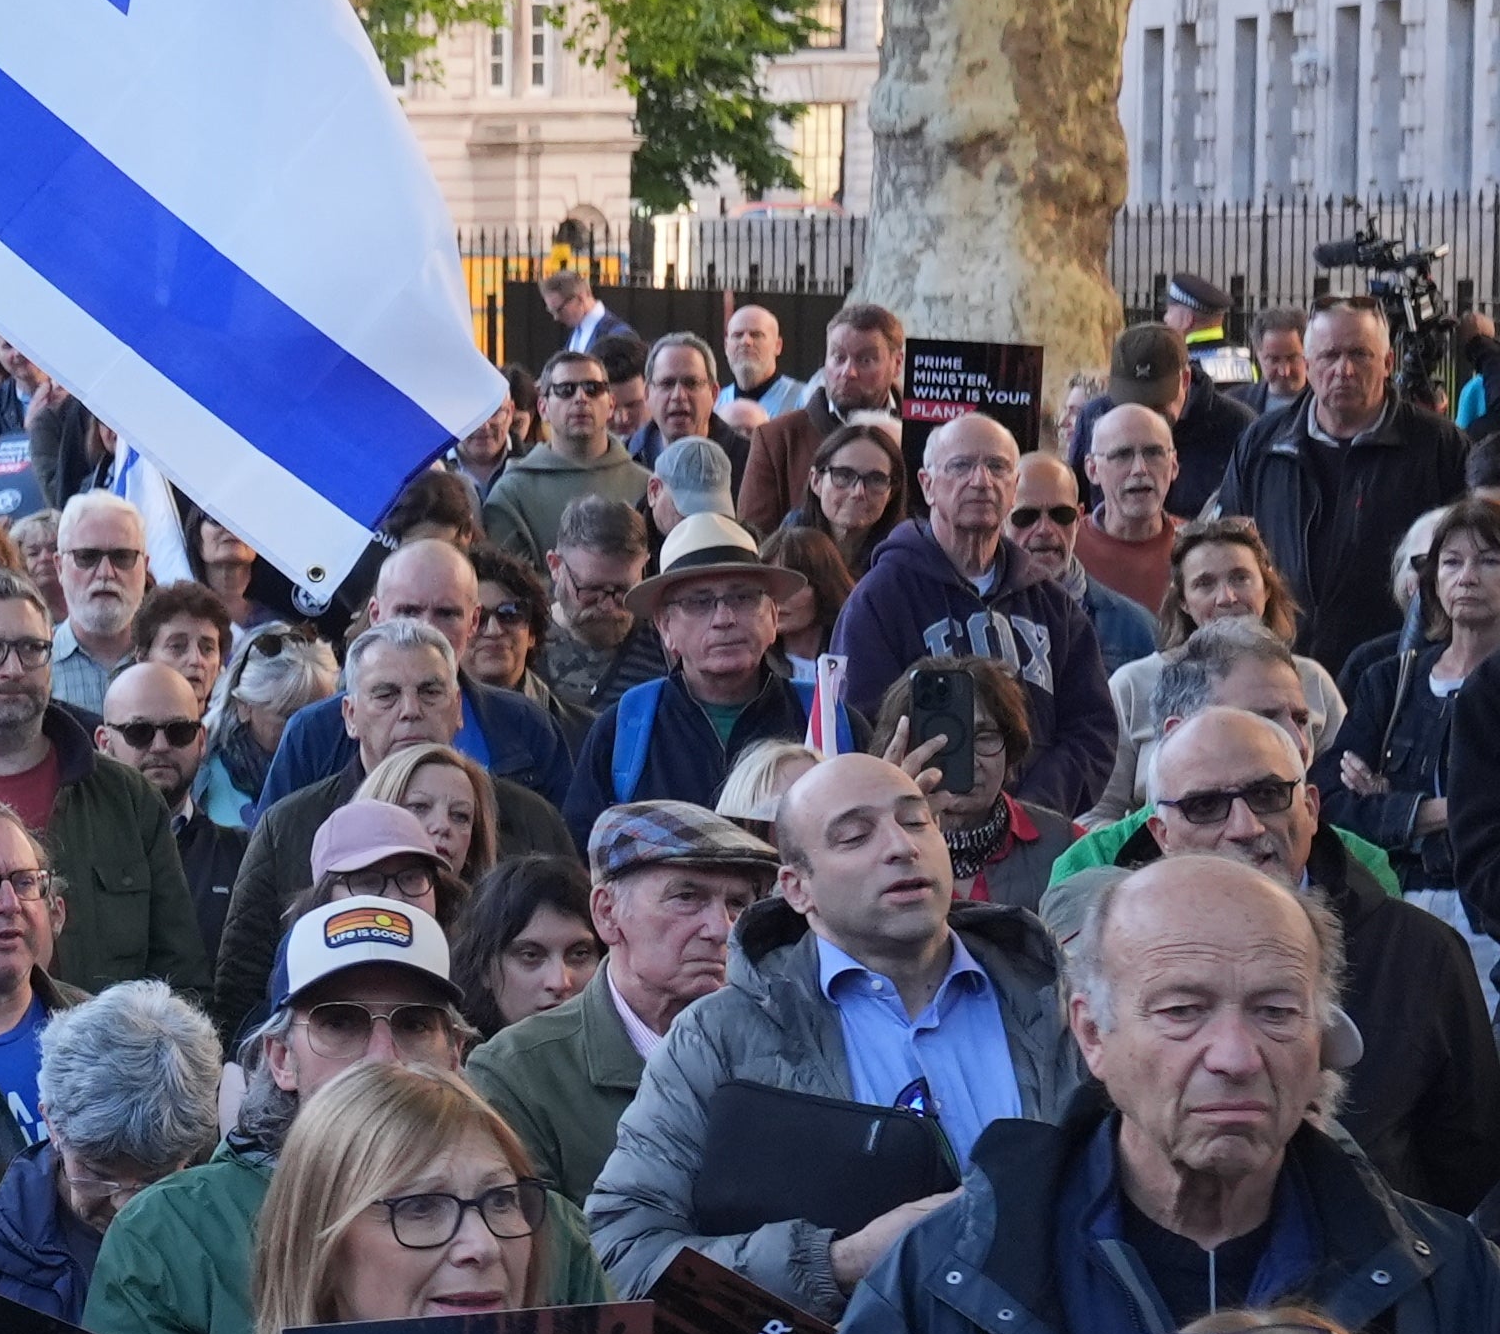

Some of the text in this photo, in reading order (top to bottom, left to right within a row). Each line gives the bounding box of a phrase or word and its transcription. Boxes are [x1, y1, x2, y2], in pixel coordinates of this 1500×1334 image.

[914, 355, 963, 371] PRIME
[913, 370, 991, 389] MINISTER,
[913, 385, 1031, 406] WHAT IS YOUR
